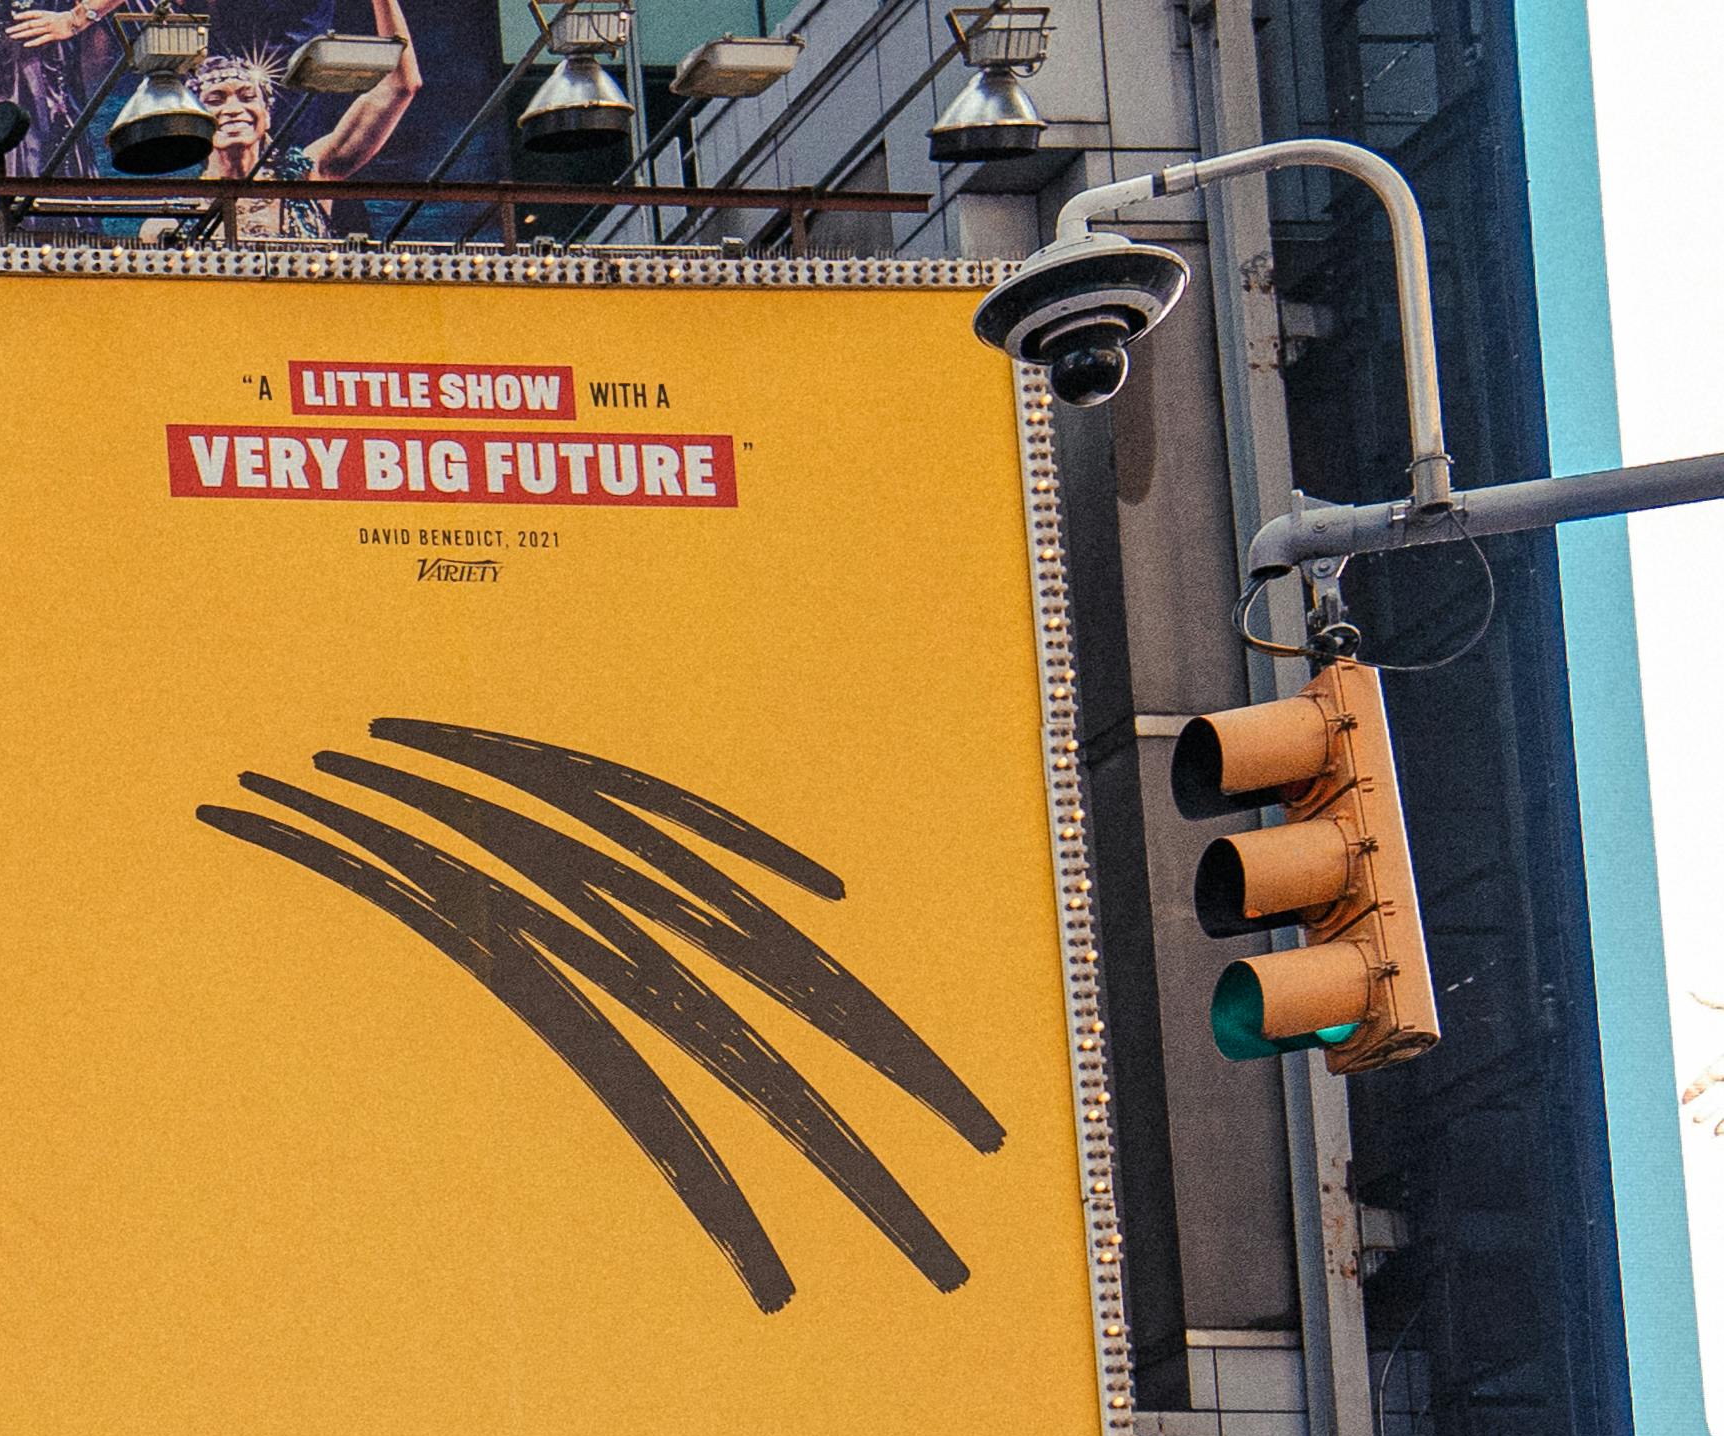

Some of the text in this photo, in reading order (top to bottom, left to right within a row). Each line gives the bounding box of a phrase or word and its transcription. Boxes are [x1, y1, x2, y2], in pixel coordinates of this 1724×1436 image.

[302, 368, 671, 412] LITTLE SHOW WITH A
[189, 435, 717, 497] VERY BIG FUTURE
[359, 527, 561, 551] DAVID BENEDICT, 2021
[416, 557, 504, 584] VARIETY
